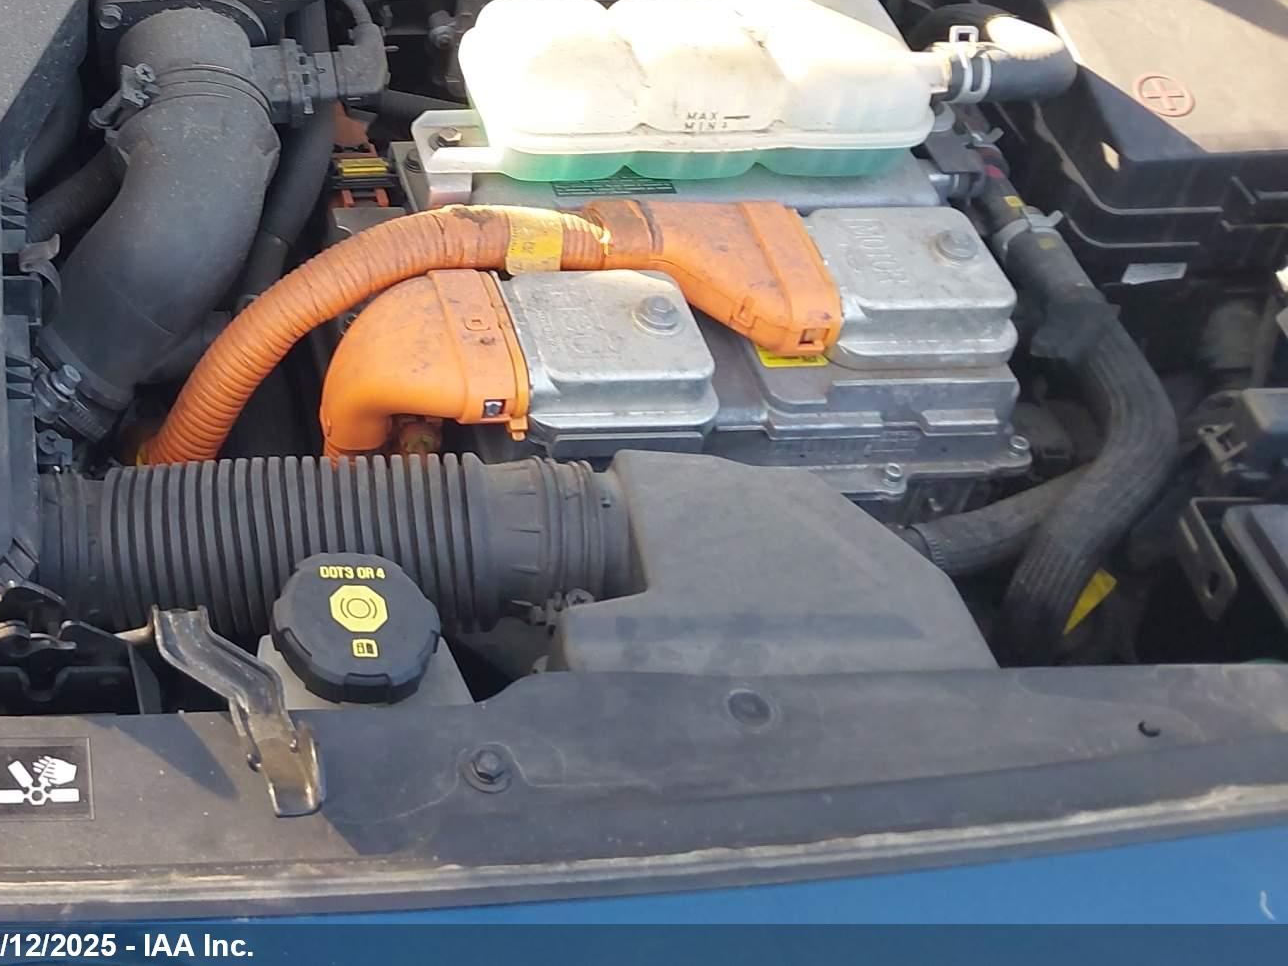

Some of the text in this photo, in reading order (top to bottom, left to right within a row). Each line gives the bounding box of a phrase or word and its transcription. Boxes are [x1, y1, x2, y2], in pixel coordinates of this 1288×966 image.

[686, 111, 718, 120] MAX
[684, 121, 716, 130] MIN
[319, 565, 386, 580] DOT3 OR 4
